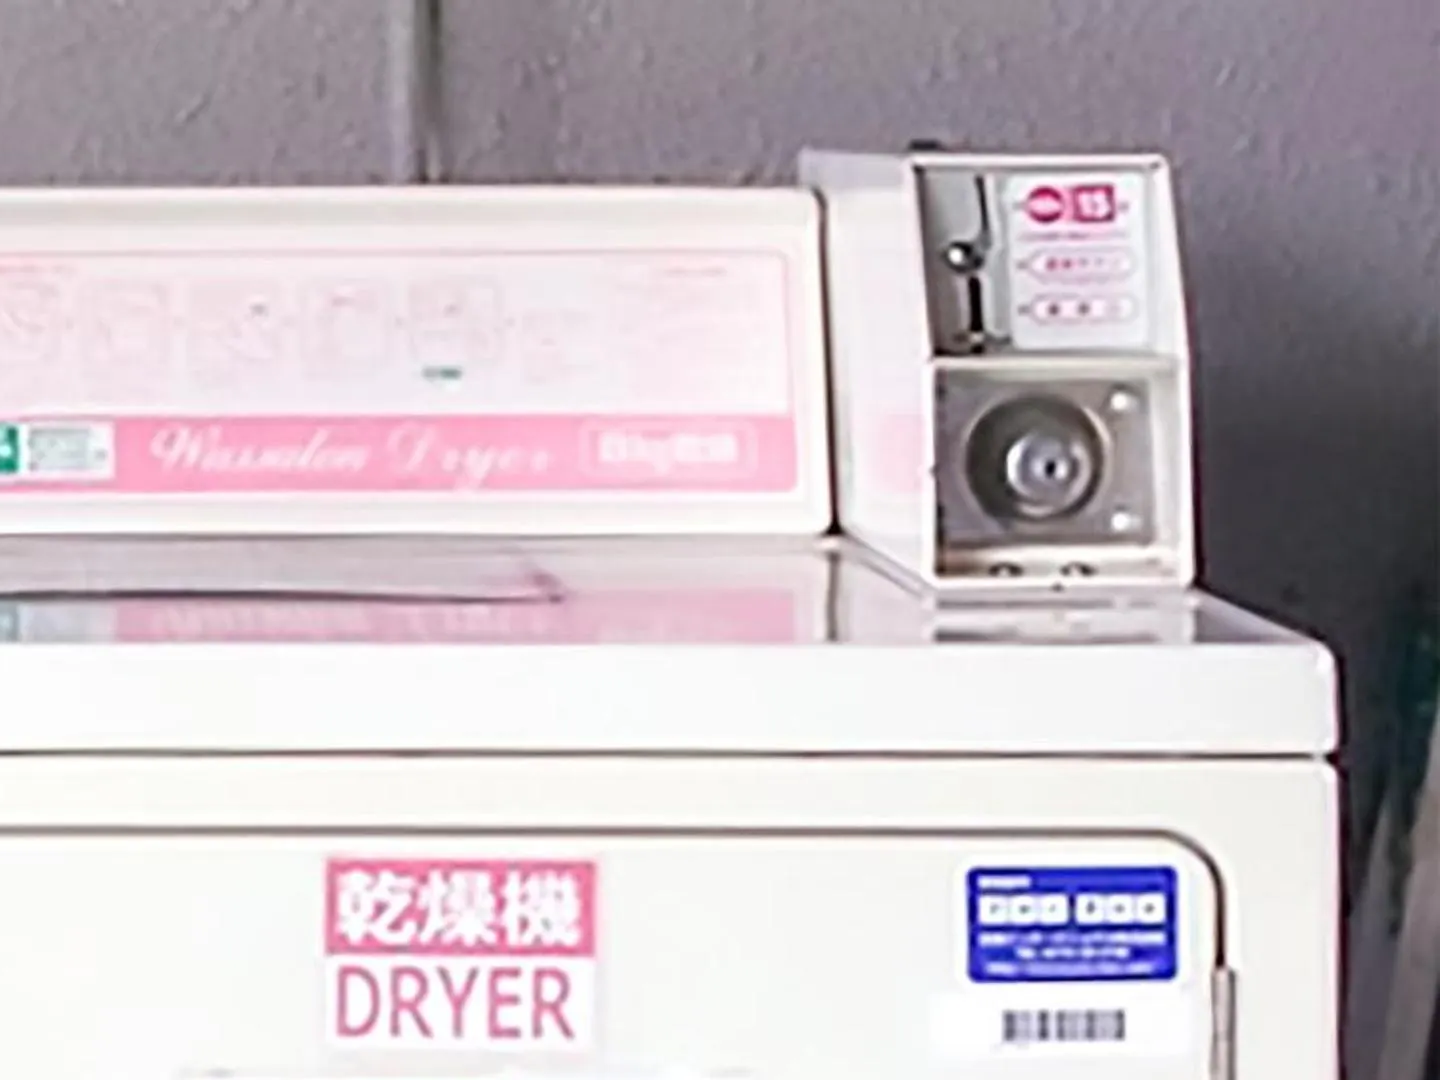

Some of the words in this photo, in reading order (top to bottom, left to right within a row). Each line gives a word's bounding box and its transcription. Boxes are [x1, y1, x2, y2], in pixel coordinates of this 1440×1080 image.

[336, 868, 583, 947] 乾燥機
[335, 964, 576, 1040] DRYER
